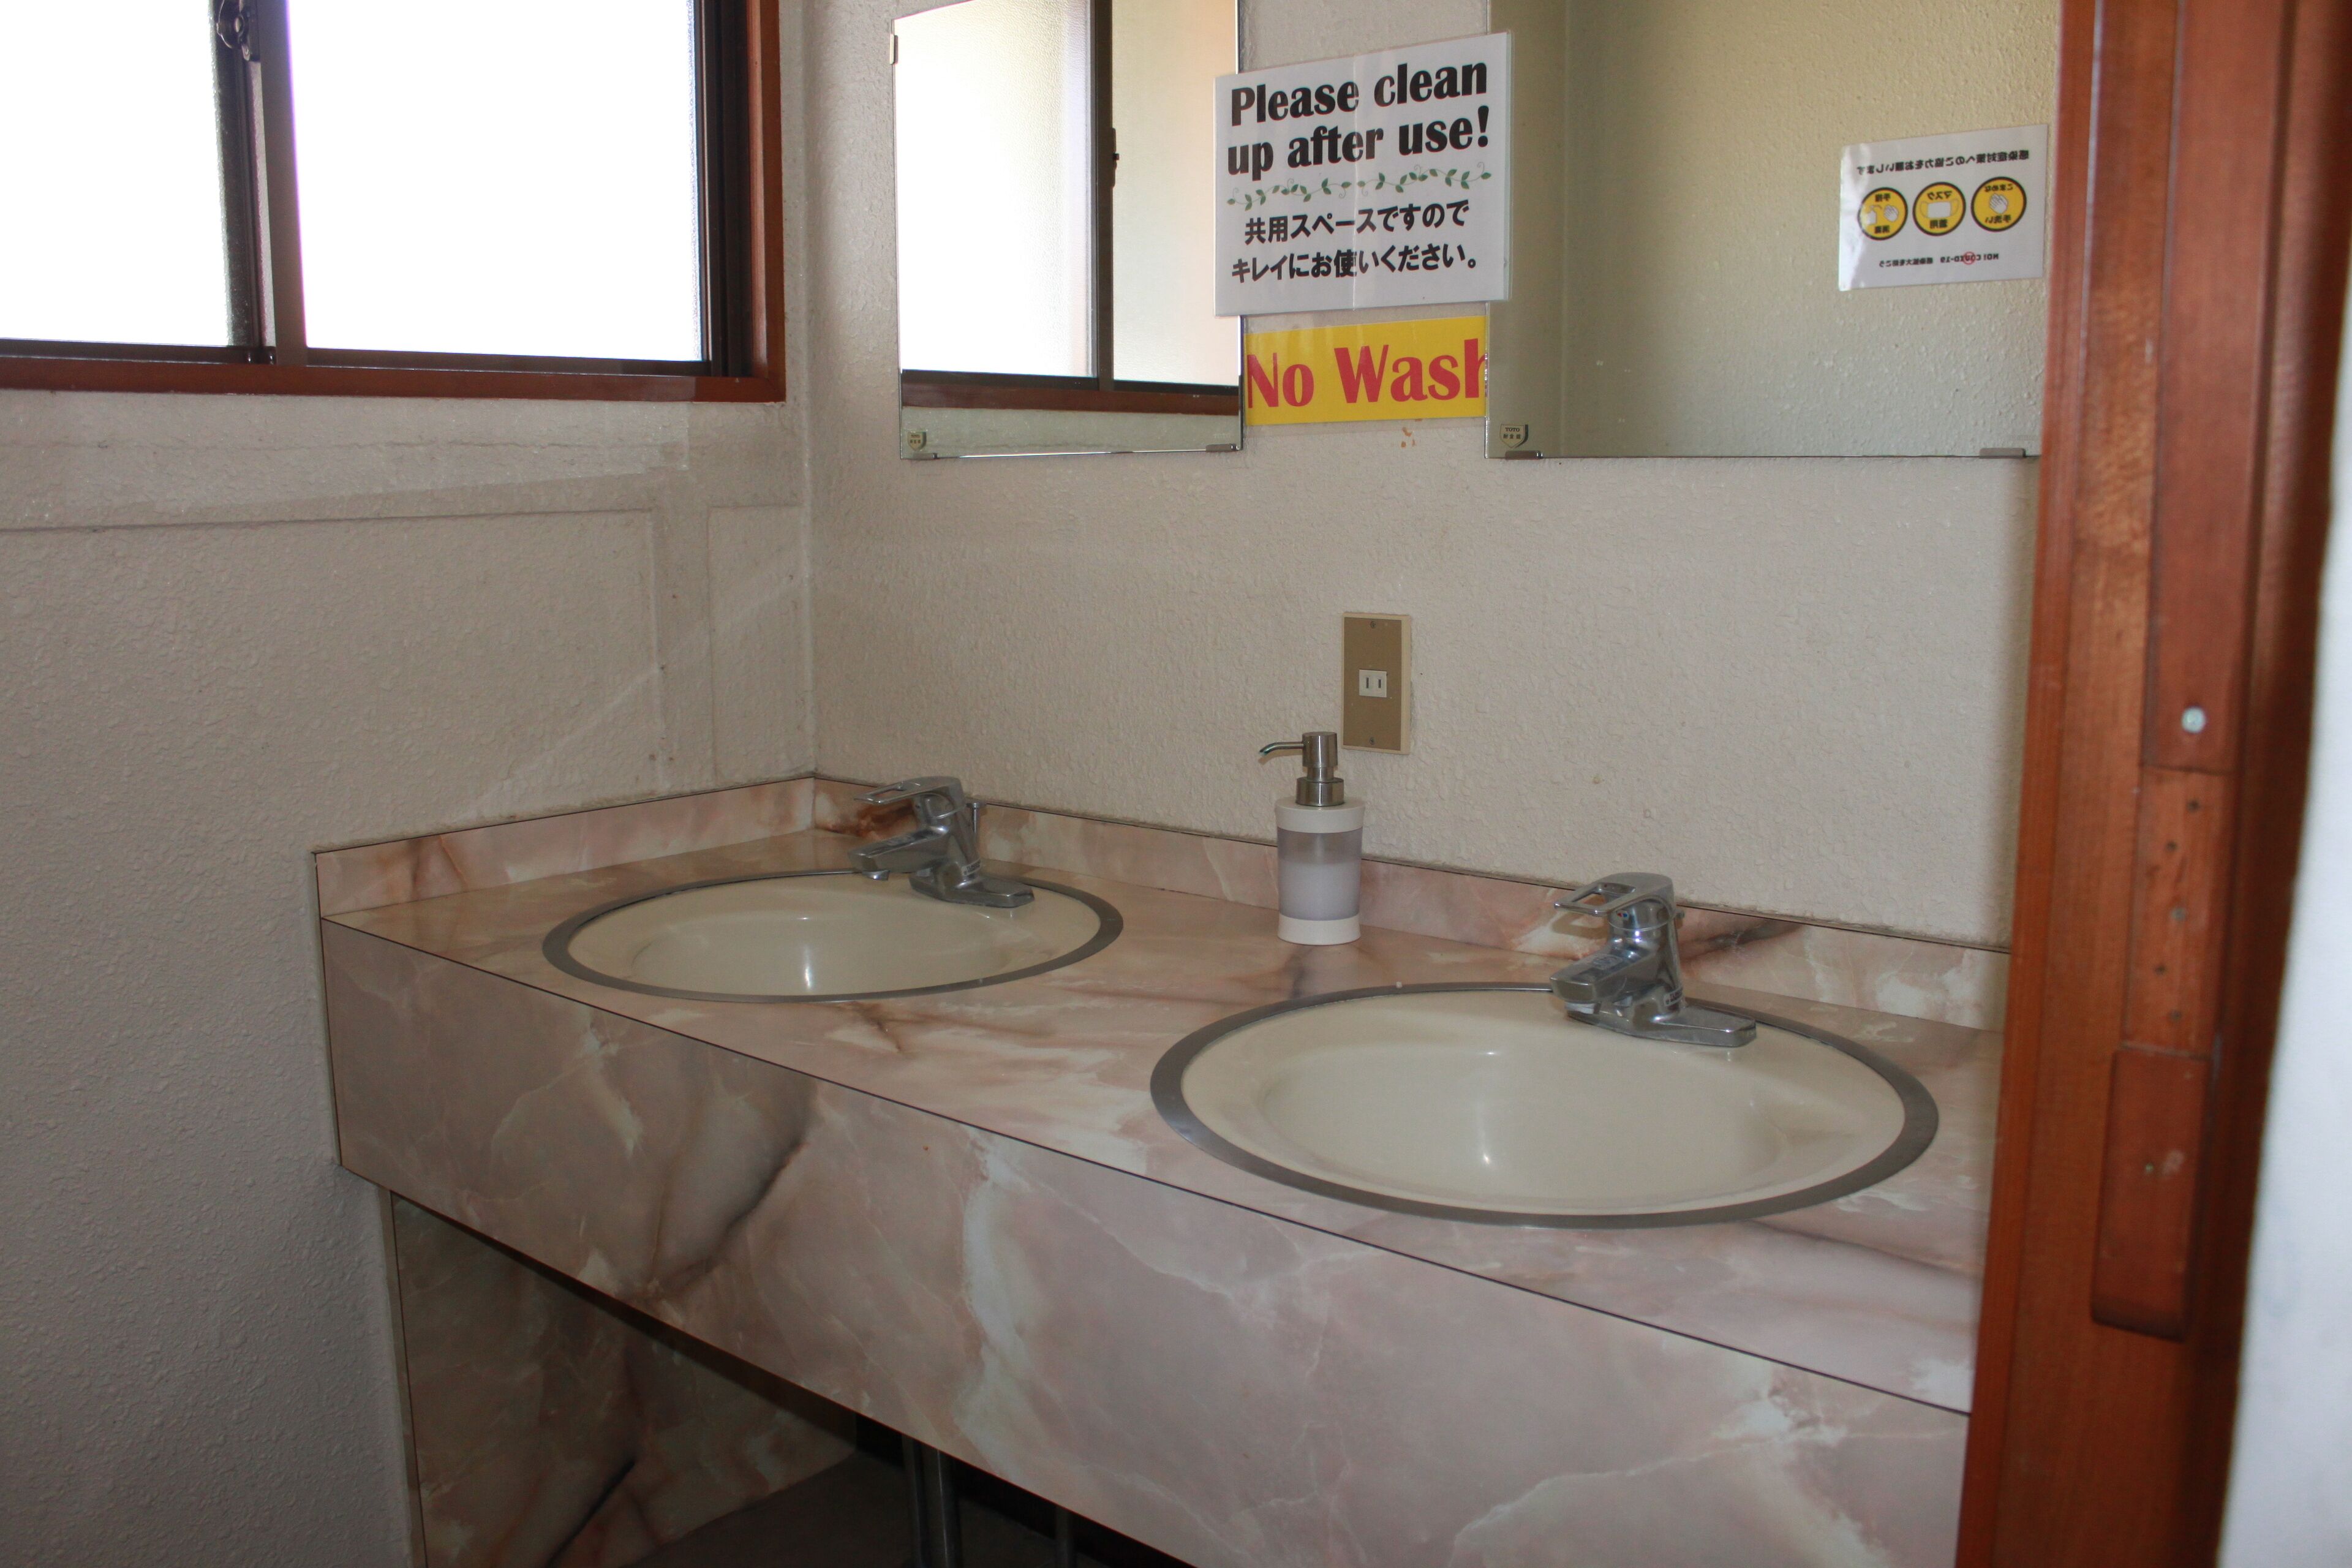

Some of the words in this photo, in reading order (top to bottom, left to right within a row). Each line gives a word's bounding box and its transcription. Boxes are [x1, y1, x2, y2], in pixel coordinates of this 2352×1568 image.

[1231, 81, 1359, 127] Please
[1374, 62, 1487, 108] clean
[1227, 141, 1273, 181] up
[1287, 125, 1384, 168] after
[1399, 105, 1489, 156] use!
[1245, 199, 1470, 245] 共用スペースですので
[1232, 243, 1477, 284] キレイにお使いください。
[1247, 352, 1314, 409] No
